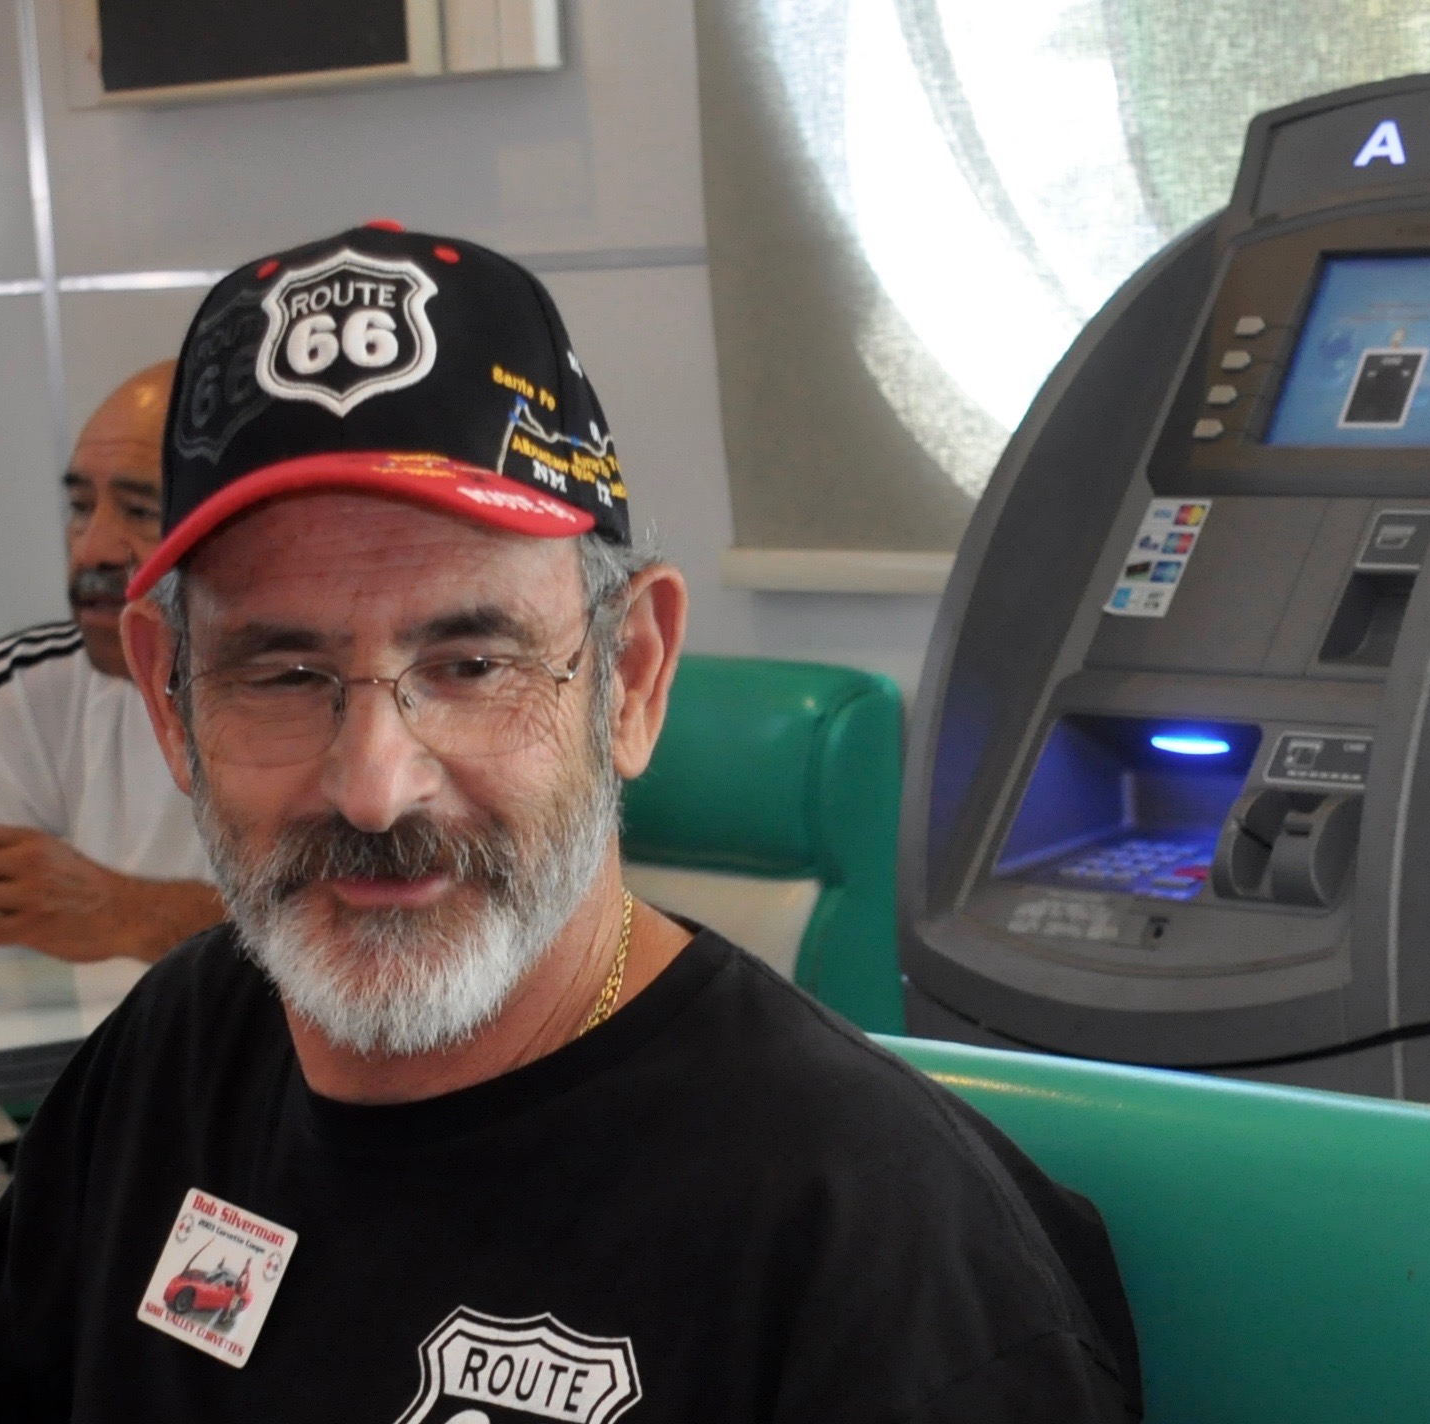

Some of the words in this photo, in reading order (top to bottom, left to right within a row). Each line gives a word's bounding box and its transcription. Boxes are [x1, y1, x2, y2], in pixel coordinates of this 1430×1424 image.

[288, 281, 398, 322] ROUTE
[286, 308, 399, 375] 66
[532, 459, 568, 494] NM
[192, 1193, 218, 1216] Bob
[220, 1205, 286, 1248] Silverman
[459, 1347, 589, 1413] ROUTE
